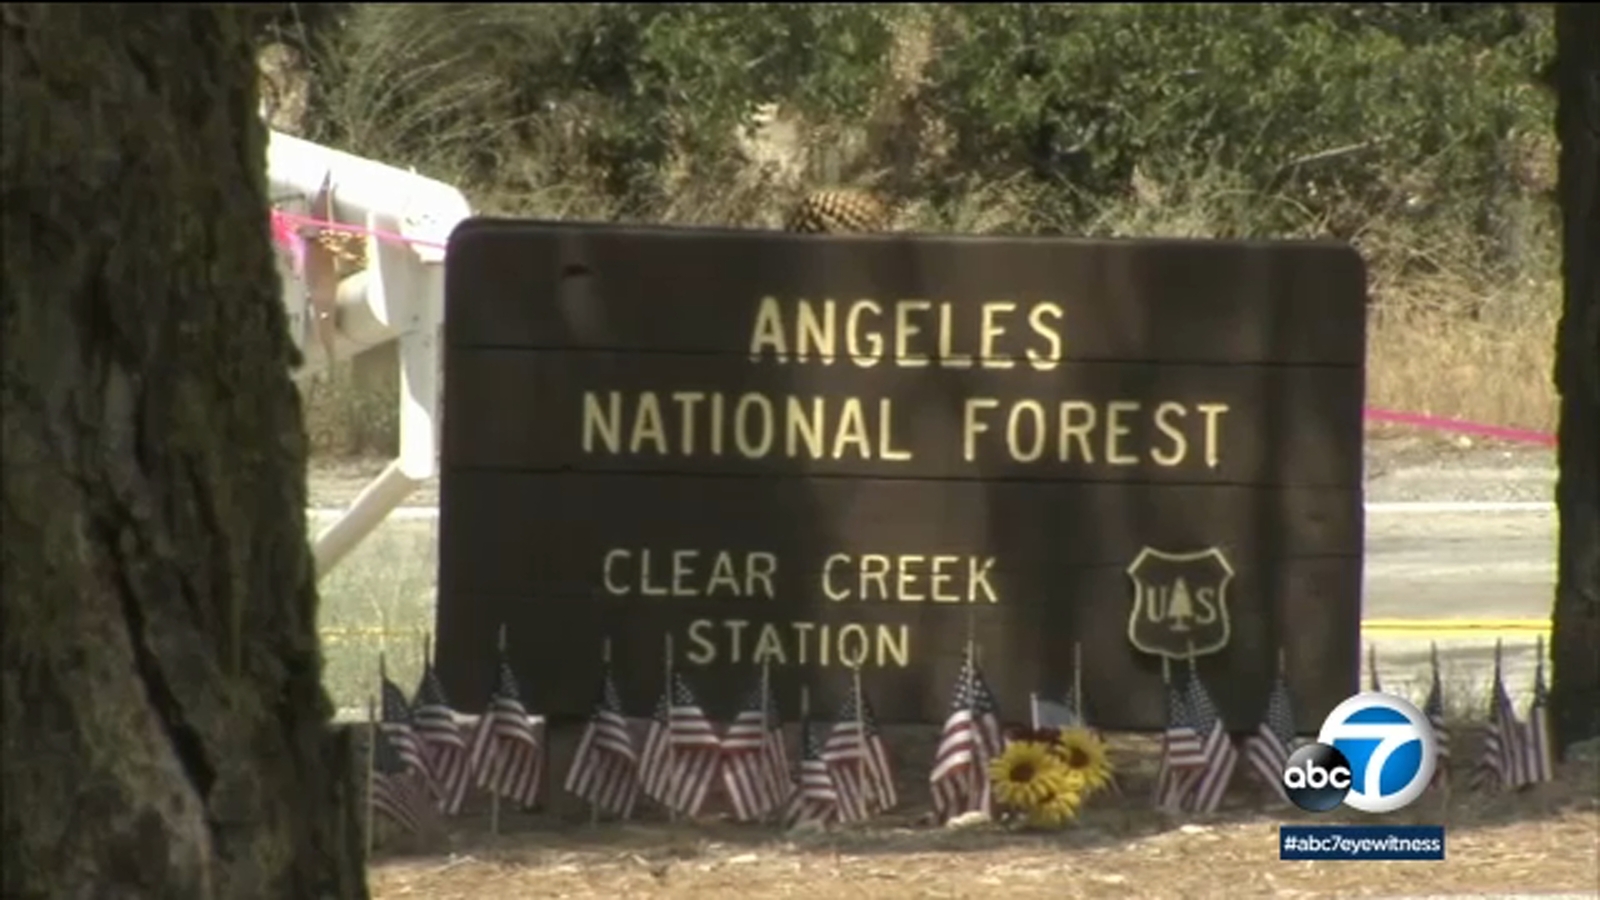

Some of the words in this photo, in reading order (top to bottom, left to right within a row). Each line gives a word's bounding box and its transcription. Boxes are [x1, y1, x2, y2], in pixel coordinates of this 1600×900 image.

[748, 296, 1063, 370] ANGELES
[581, 391, 912, 461] NATIONAL
[963, 398, 1229, 468] FOREST
[602, 548, 778, 599] CLEAR
[821, 553, 999, 603] CREEK
[686, 620, 909, 668] STATION
